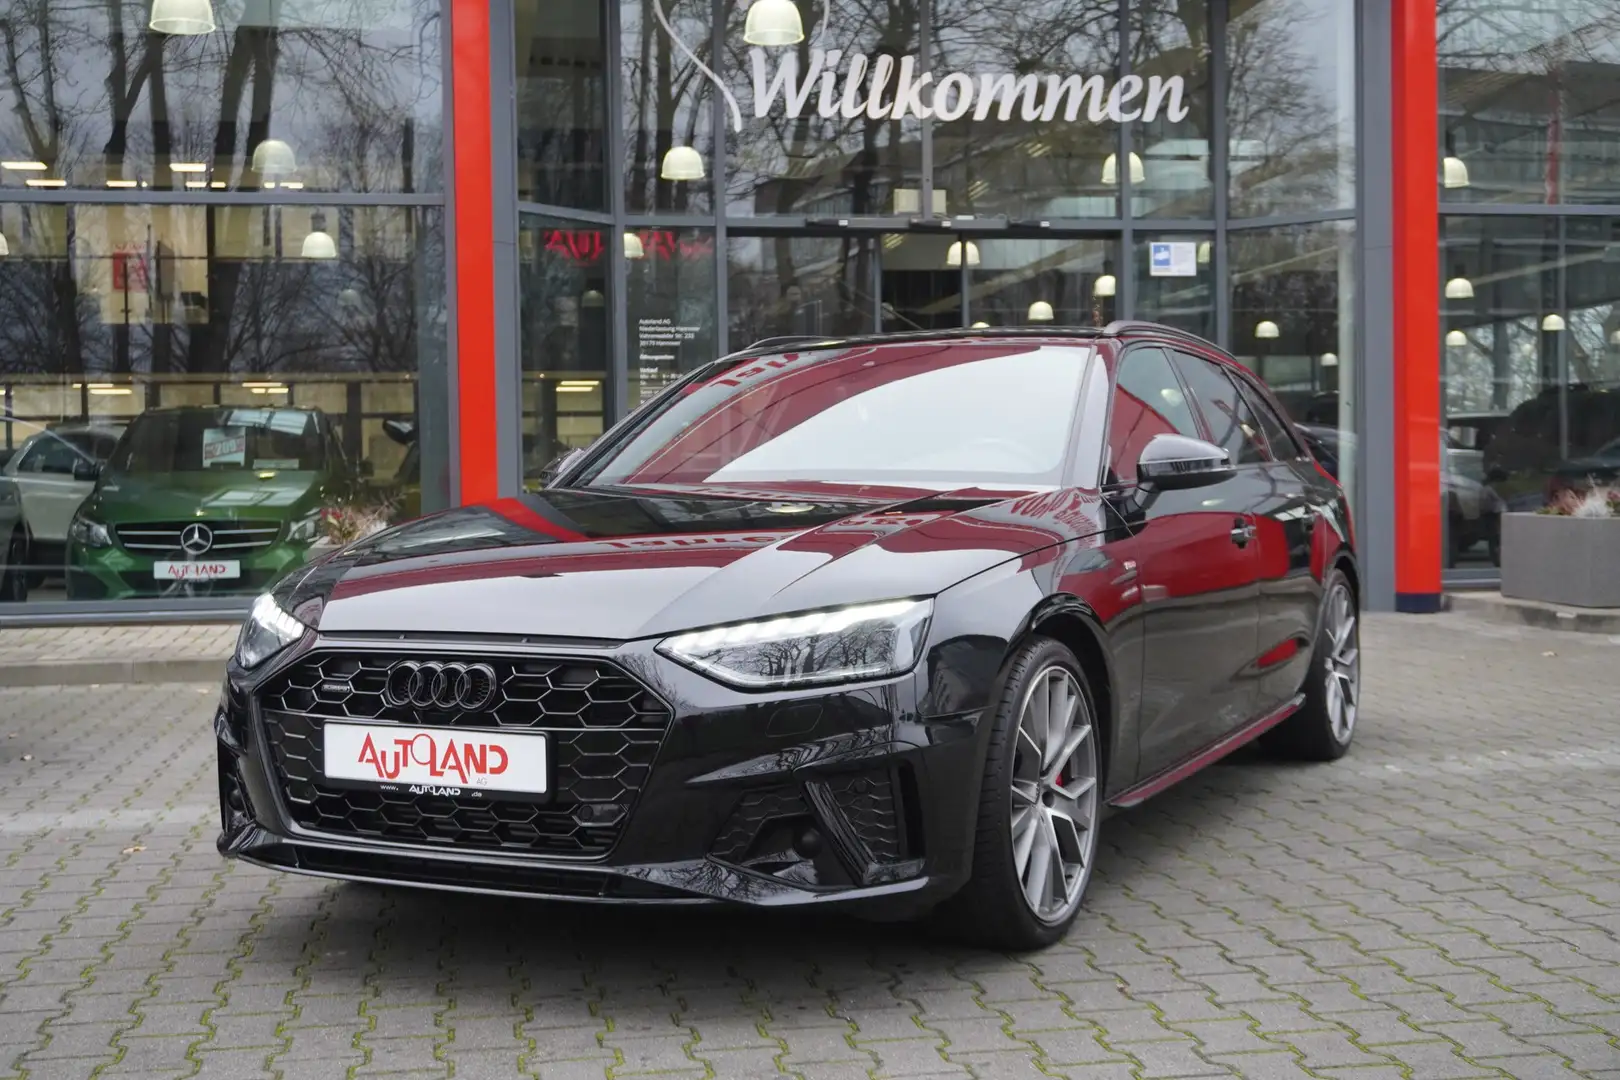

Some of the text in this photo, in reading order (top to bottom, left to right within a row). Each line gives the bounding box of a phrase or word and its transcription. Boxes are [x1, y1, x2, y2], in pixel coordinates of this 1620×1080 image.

[749, 48, 1189, 123] Willkommen
[358, 732, 509, 784] AUTOLAND
[408, 784, 461, 798] AUTOLAND
[476, 776, 489, 787] AG
